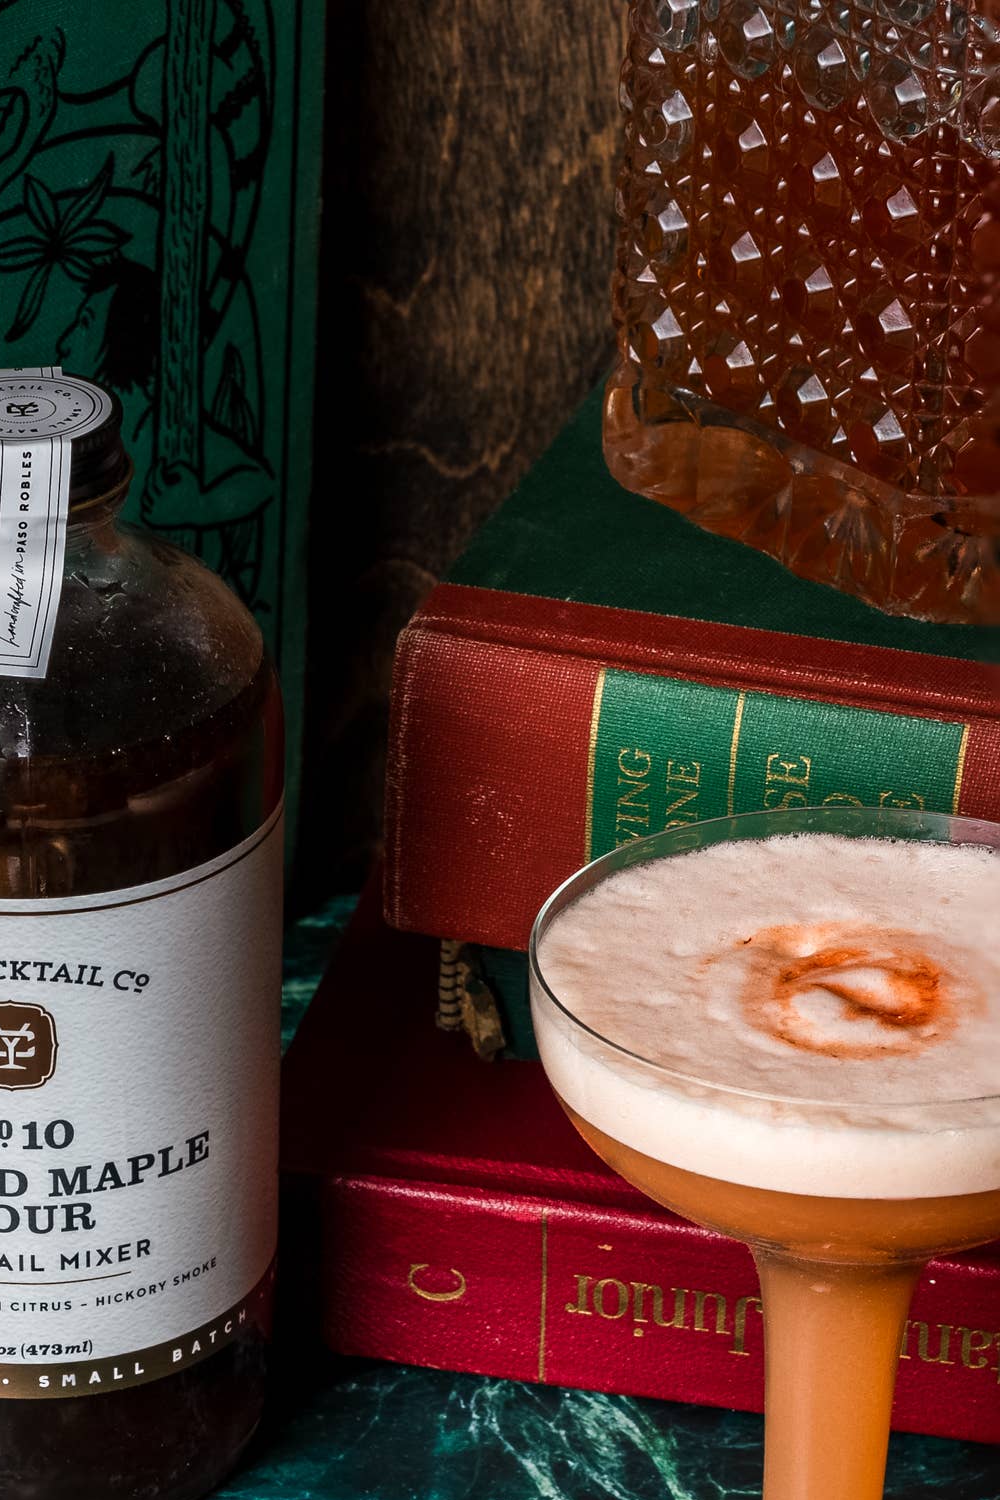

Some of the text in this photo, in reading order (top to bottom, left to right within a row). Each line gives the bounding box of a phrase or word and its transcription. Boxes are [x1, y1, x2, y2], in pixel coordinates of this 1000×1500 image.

[48, 408, 82, 430] SMALL
[19, 451, 32, 512] ROBLES
[15, 521, 28, 553] PASO
[12, 553, 25, 575] in
[22, 1119, 75, 1150] 10
[48, 1129, 210, 1197] MAPLE
[60, 1238, 151, 1272] MIXER
[10, 1301, 72, 1312] CITRUS
[96, 1280, 167, 1306] HICKORY
[173, 1257, 217, 1286] SMOKE
[565, 1274, 763, 1356] Junior
[20, 1339, 93, 1360] (473ml)
[38, 1362, 144, 1388] SMALL
[172, 1309, 246, 1363] BATCH
